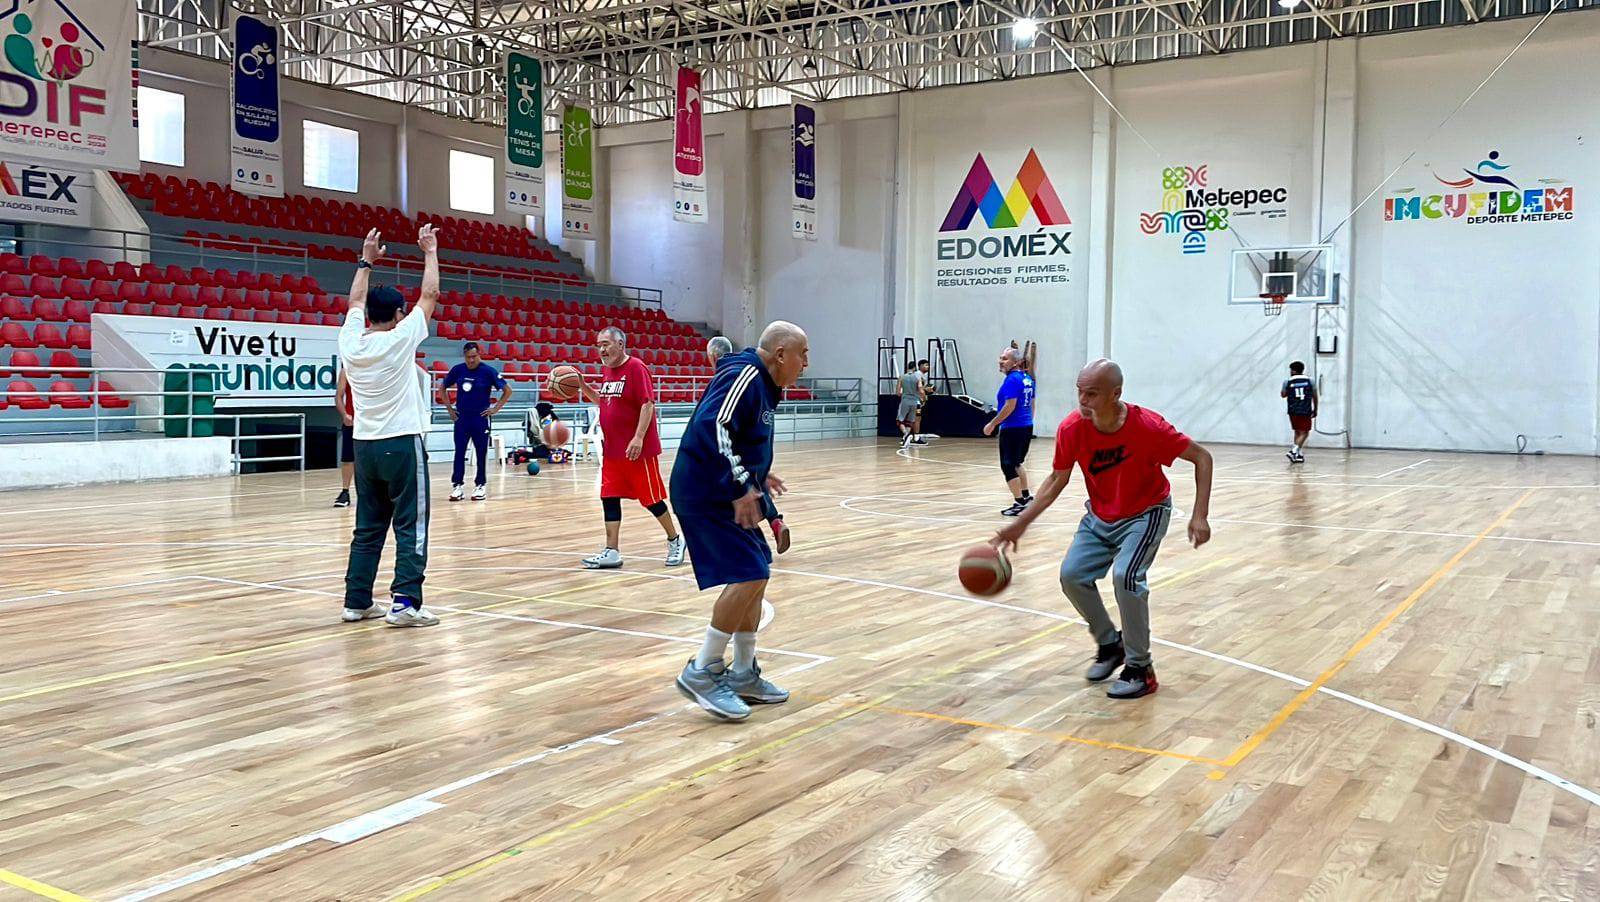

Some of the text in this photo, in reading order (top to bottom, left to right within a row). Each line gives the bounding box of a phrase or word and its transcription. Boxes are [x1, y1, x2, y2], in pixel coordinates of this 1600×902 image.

[510, 136, 530, 147] TENIS
[515, 147, 536, 157] MESA
[566, 179, 591, 189] DANZA
[1186, 187, 1287, 208] Metepec
[1384, 187, 1573, 221] IMCUFIDEM
[1467, 211, 1573, 225] DEPORTE METEPEC
[937, 228, 1072, 260] EDOMÉX
[937, 264, 1069, 277] DECISIONES FIRMES.
[937, 275, 1069, 287] RESULTADOS FUERTES.
[195, 326, 296, 357] Vive tu
